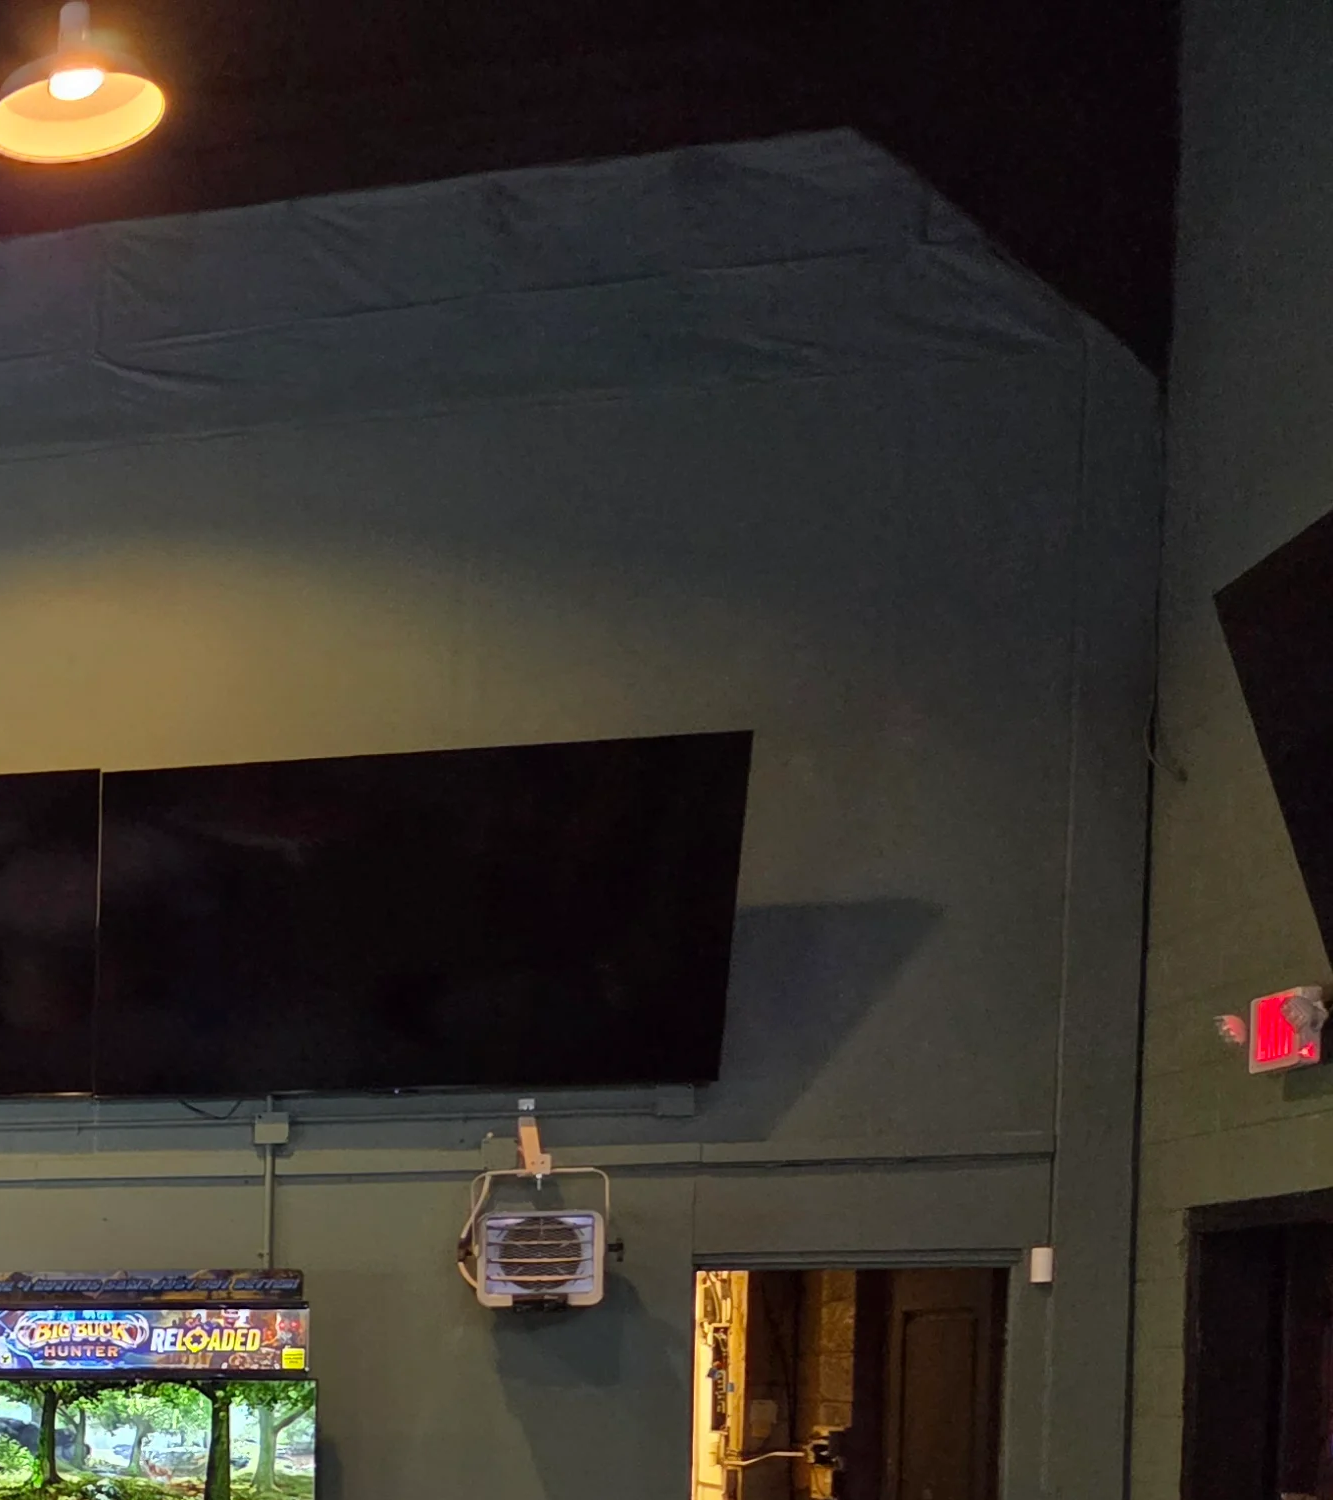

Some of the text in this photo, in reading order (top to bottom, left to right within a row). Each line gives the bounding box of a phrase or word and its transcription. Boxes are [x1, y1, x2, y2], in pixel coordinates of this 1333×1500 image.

[34, 1322, 132, 1342] BIG BUCK
[150, 1327, 262, 1353] RELOADED
[44, 1345, 119, 1358] HUNTER
